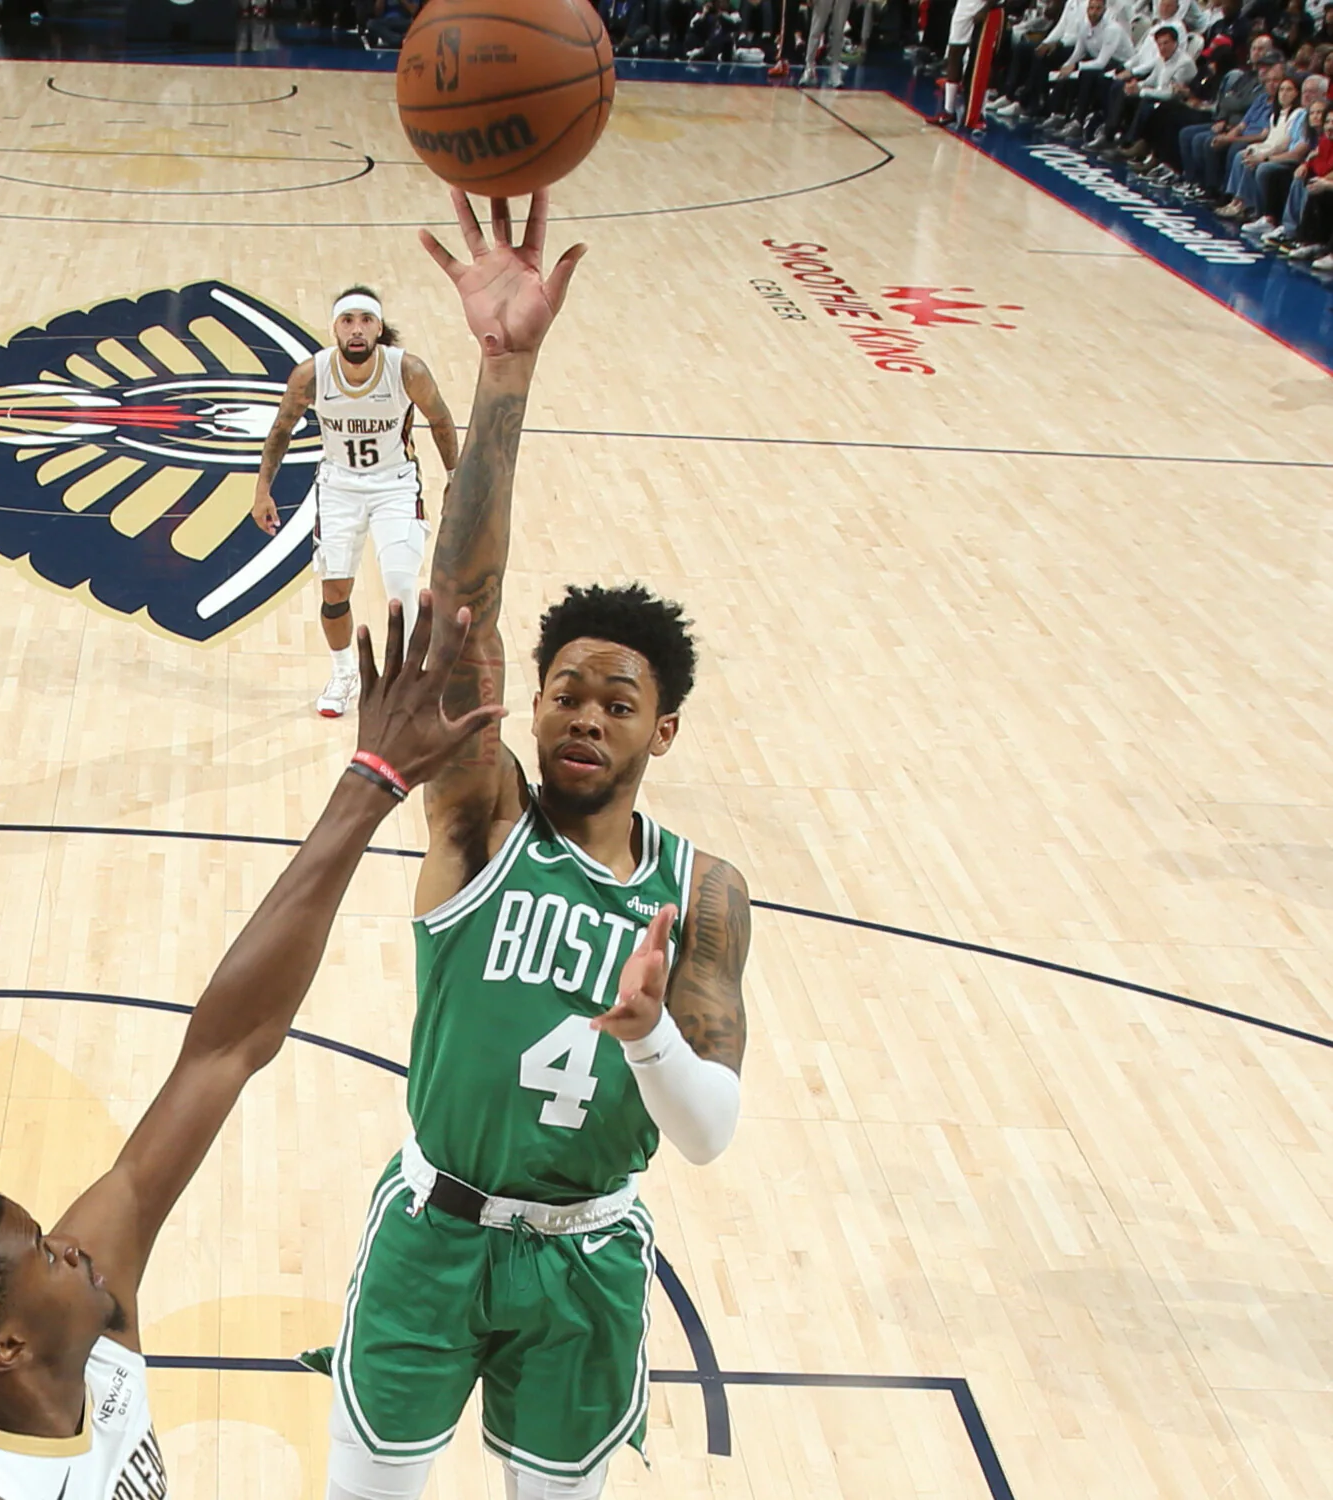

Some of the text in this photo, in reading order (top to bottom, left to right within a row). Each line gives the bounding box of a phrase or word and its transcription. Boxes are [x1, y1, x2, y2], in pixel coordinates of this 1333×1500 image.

[406, 113, 538, 166] Wilson
[1120, 206, 1265, 264] Health
[749, 278, 807, 321] CENTER
[762, 239, 883, 321] SMOOTHIE
[347, 417, 399, 433] ORLEANS
[344, 438, 379, 468] 15
[626, 895, 678, 920] Ami
[519, 1013, 601, 1129] 4
